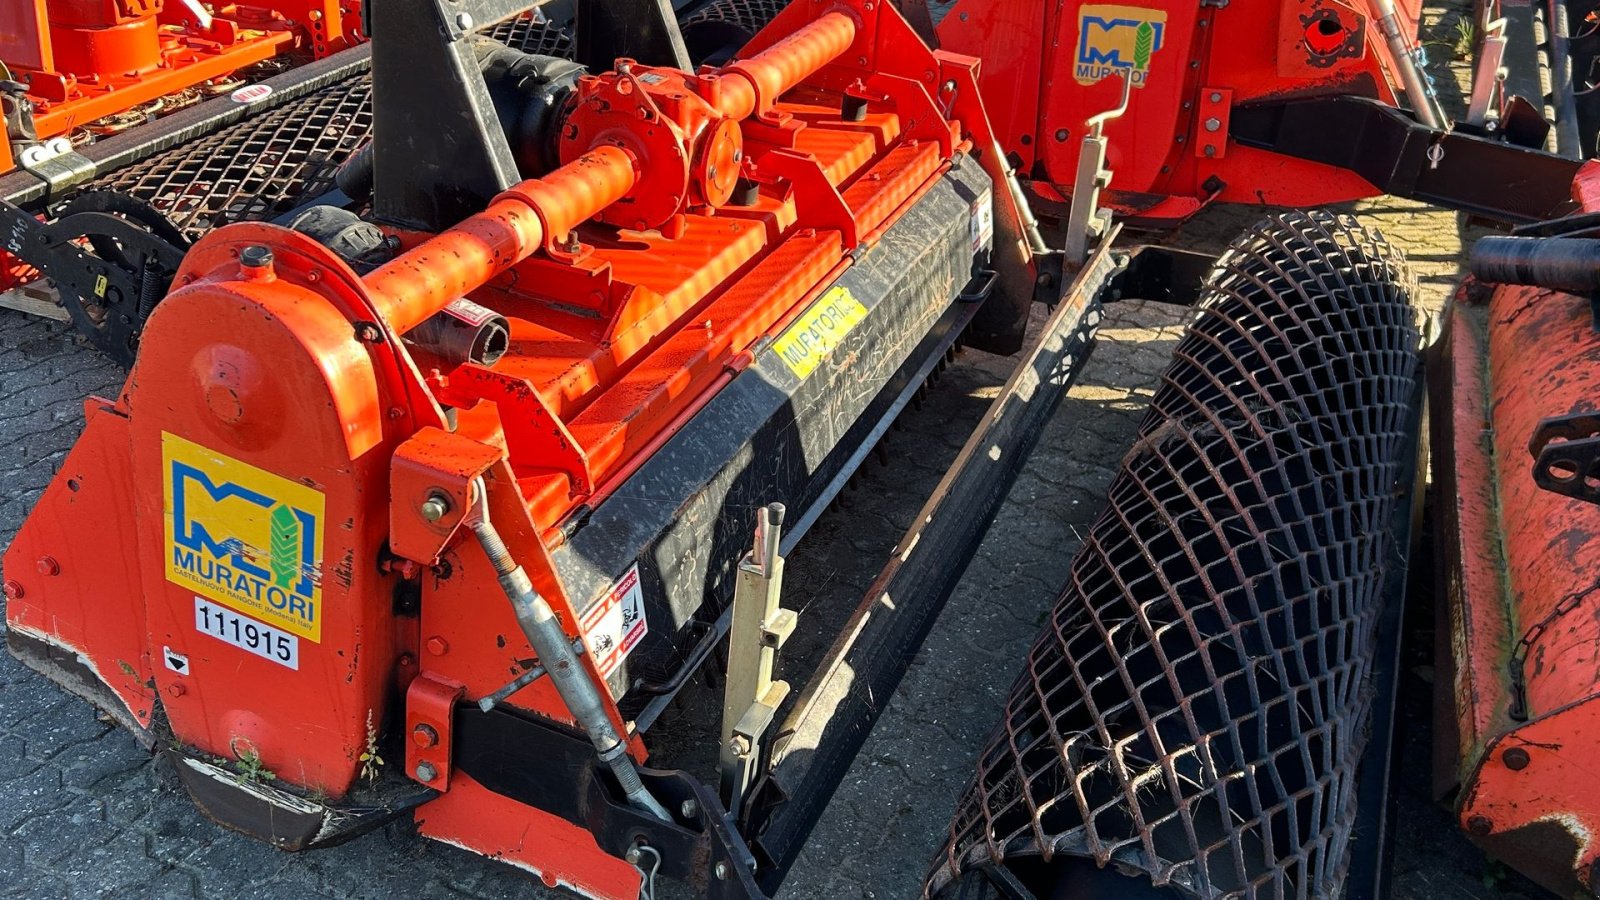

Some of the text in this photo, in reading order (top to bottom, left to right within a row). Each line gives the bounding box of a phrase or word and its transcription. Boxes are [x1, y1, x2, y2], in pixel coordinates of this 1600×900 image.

[173, 567, 313, 631] CASTELNUOVO RANGONE (Modena) Italy
[174, 546, 314, 622] MURATORI
[200, 606, 291, 661] 111915
